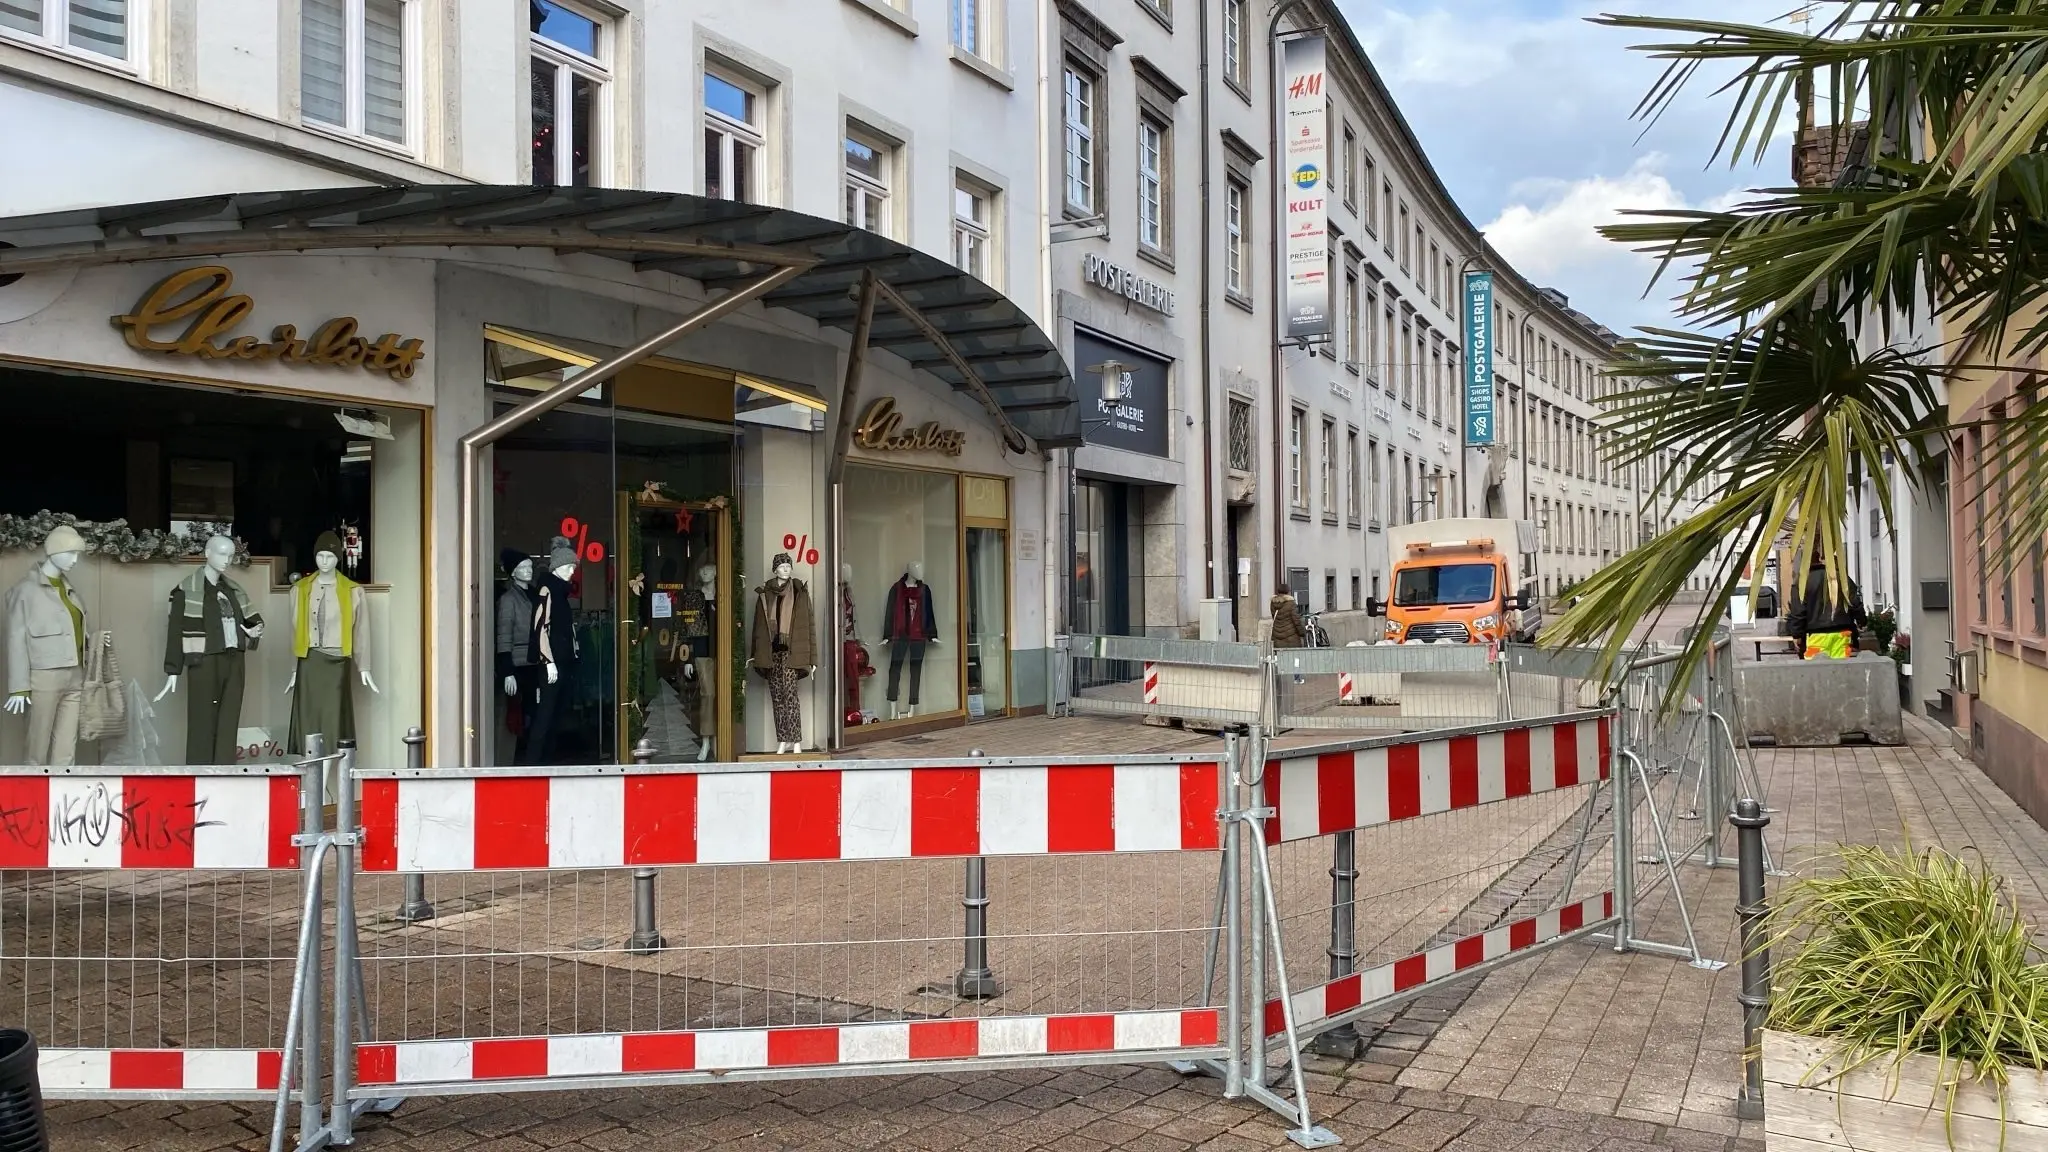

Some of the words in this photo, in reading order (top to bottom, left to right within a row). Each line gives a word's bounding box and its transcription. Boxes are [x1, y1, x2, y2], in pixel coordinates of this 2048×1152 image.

[1289, 72, 1322, 99] H&M
[1289, 199, 1324, 213] KULT
[1290, 250, 1324, 260] PRESTIGE
[1084, 253, 1174, 317] POSTGALERIE
[1474, 293, 1486, 383] POSTGALERIE
[1469, 395, 1491, 403] GASTRO
[1471, 388, 1490, 396] SHOPS
[1097, 398, 1144, 423] POGALERIE
